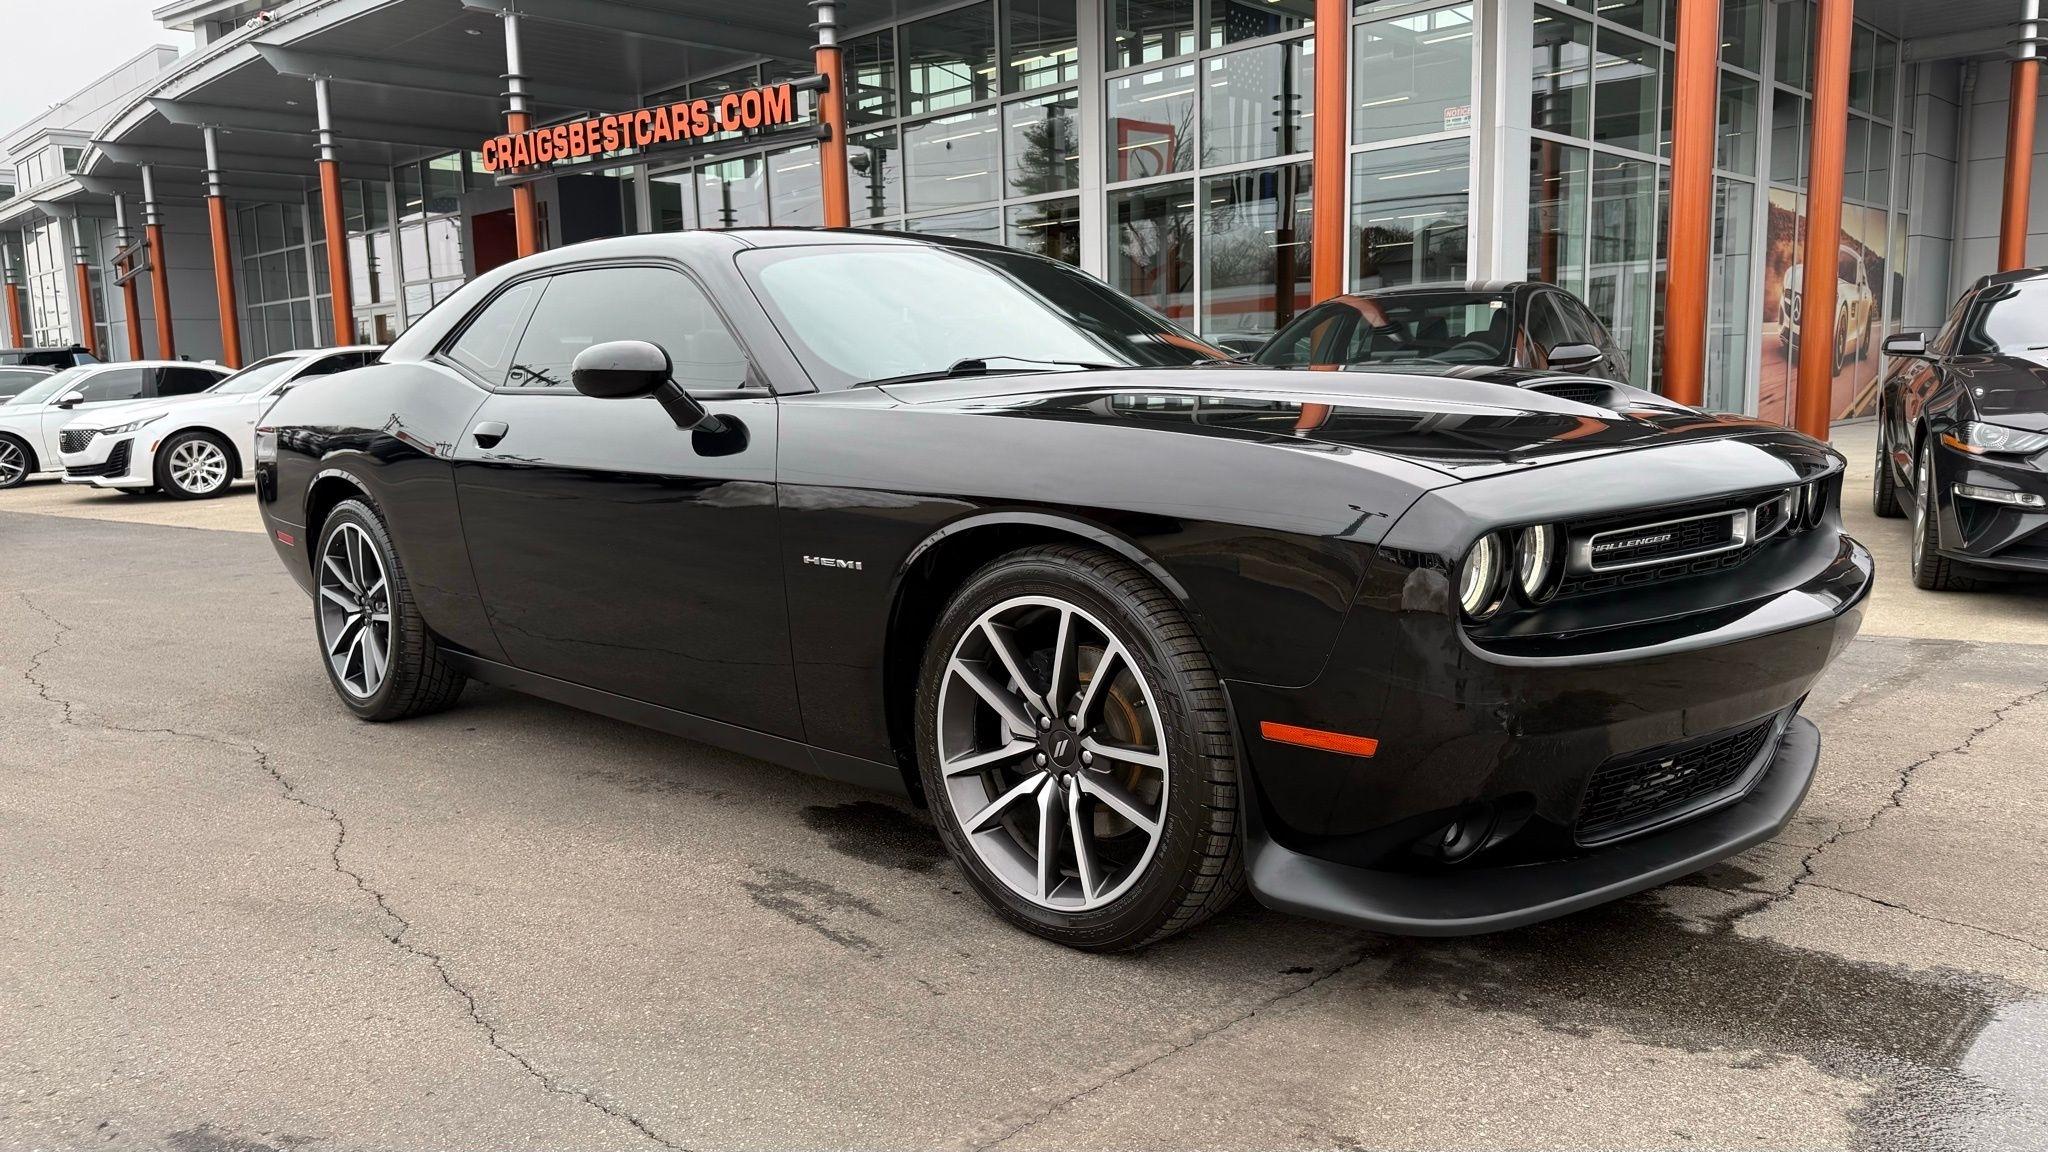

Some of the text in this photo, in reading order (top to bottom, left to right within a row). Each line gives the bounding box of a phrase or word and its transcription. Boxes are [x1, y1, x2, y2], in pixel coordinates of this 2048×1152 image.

[482, 83, 793, 172] CRAIGSBESTCARS.COM
[1591, 534, 1671, 552] HALLENGER
[803, 555, 862, 570] HEMI
